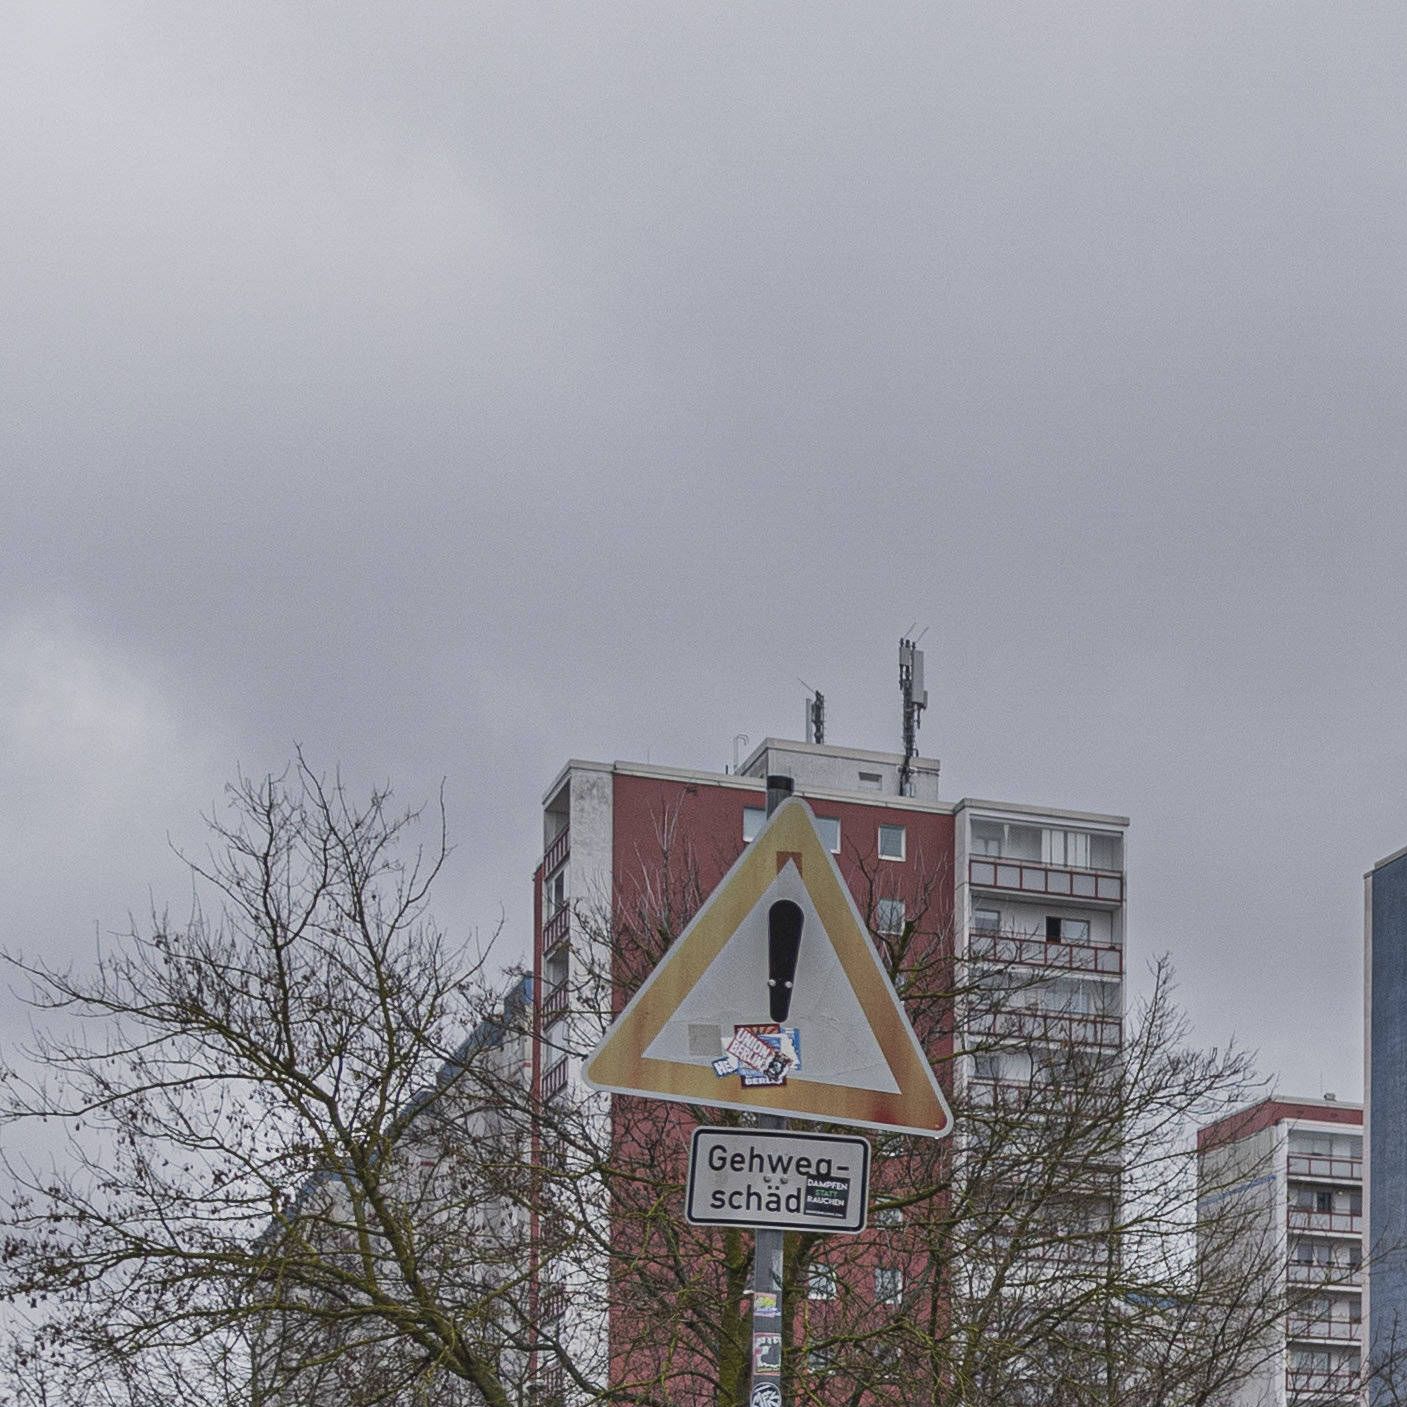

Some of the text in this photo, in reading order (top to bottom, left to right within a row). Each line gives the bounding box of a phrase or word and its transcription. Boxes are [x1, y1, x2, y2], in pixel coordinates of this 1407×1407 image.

[736, 1027, 770, 1058] UNION
[708, 1144, 849, 1177] Gehweg-
[807, 1178, 848, 1190] DAMPFEN
[815, 1189, 838, 1197] STATT
[710, 1184, 802, 1213] schäd
[807, 1195, 845, 1206] RAUCHEN
